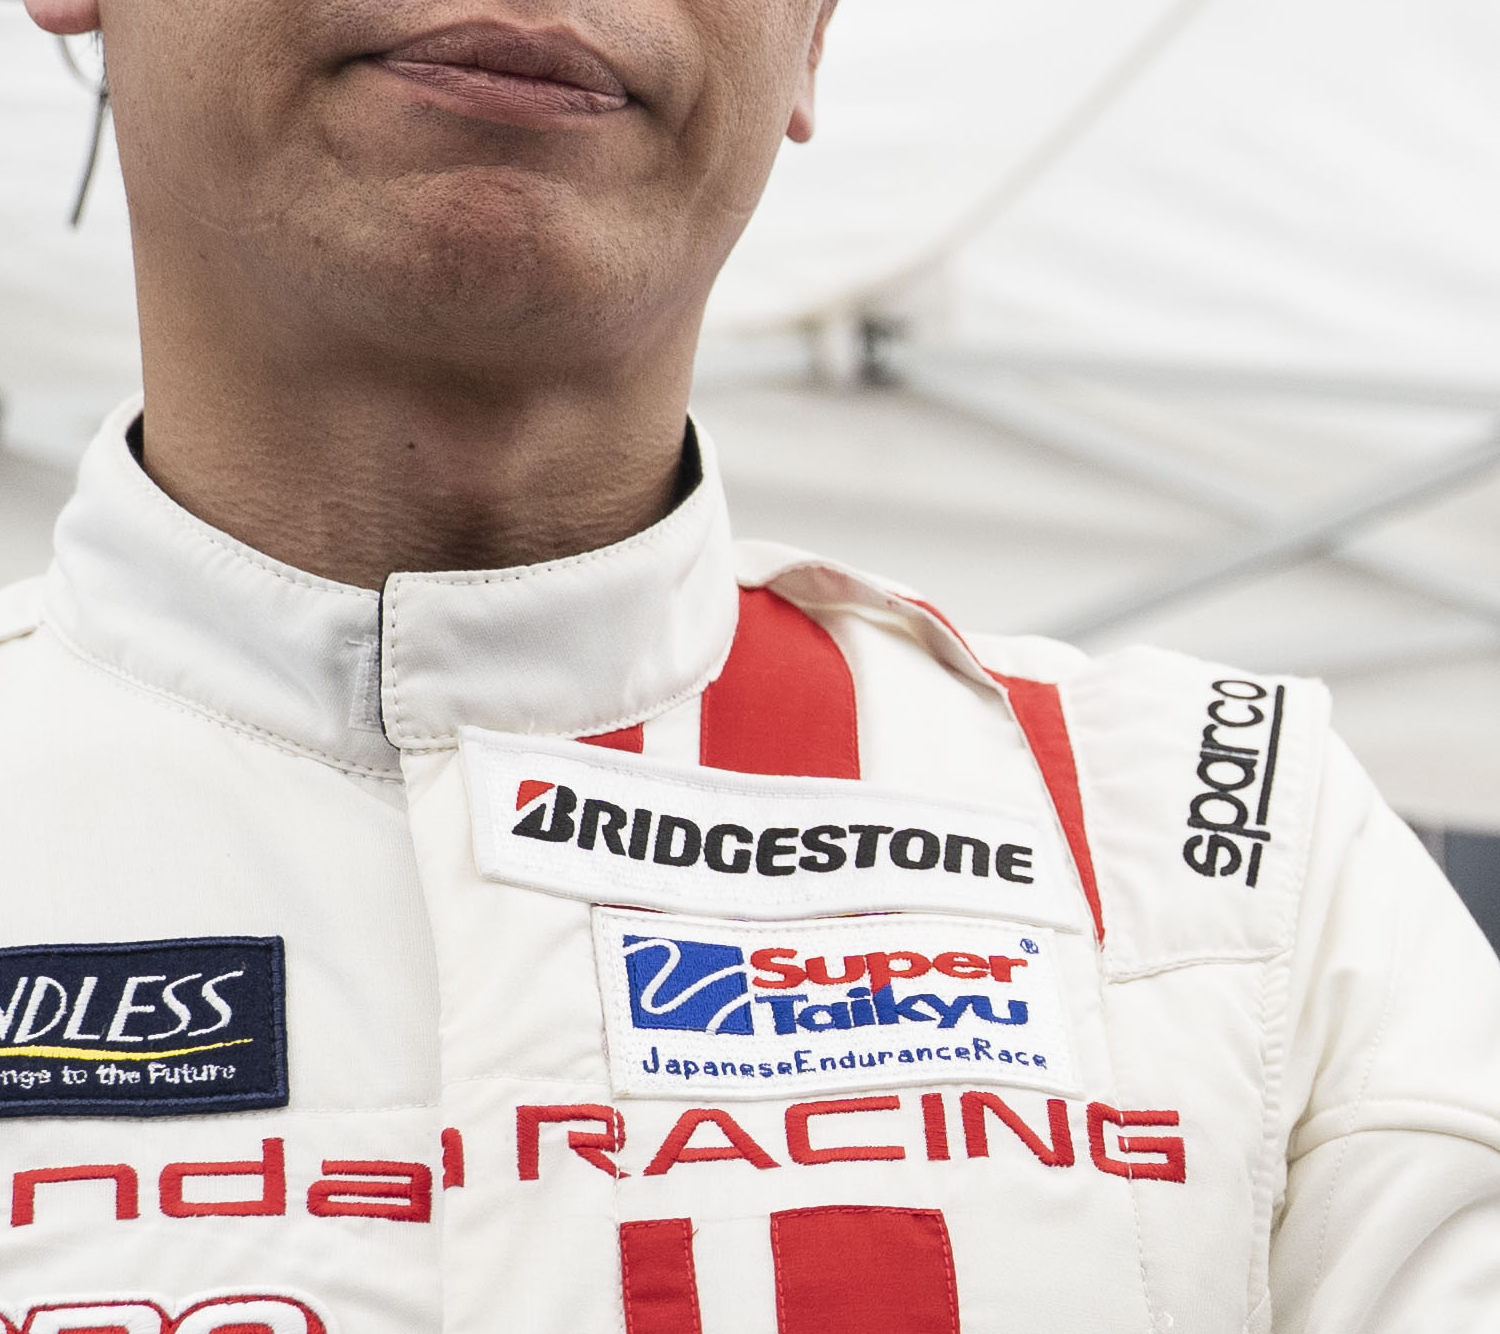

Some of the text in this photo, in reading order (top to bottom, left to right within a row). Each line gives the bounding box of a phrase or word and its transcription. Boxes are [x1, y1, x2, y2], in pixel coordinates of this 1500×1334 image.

[1184, 679, 1285, 887] sparco
[512, 779, 1034, 885] BRIDGESTONE
[750, 948, 1028, 994] Super
[754, 985, 1029, 1036] Taikyu
[63, 1065, 88, 1085] to
[95, 1063, 141, 1085] the
[147, 1061, 237, 1085] Future
[515, 1091, 1187, 1185] RACING
